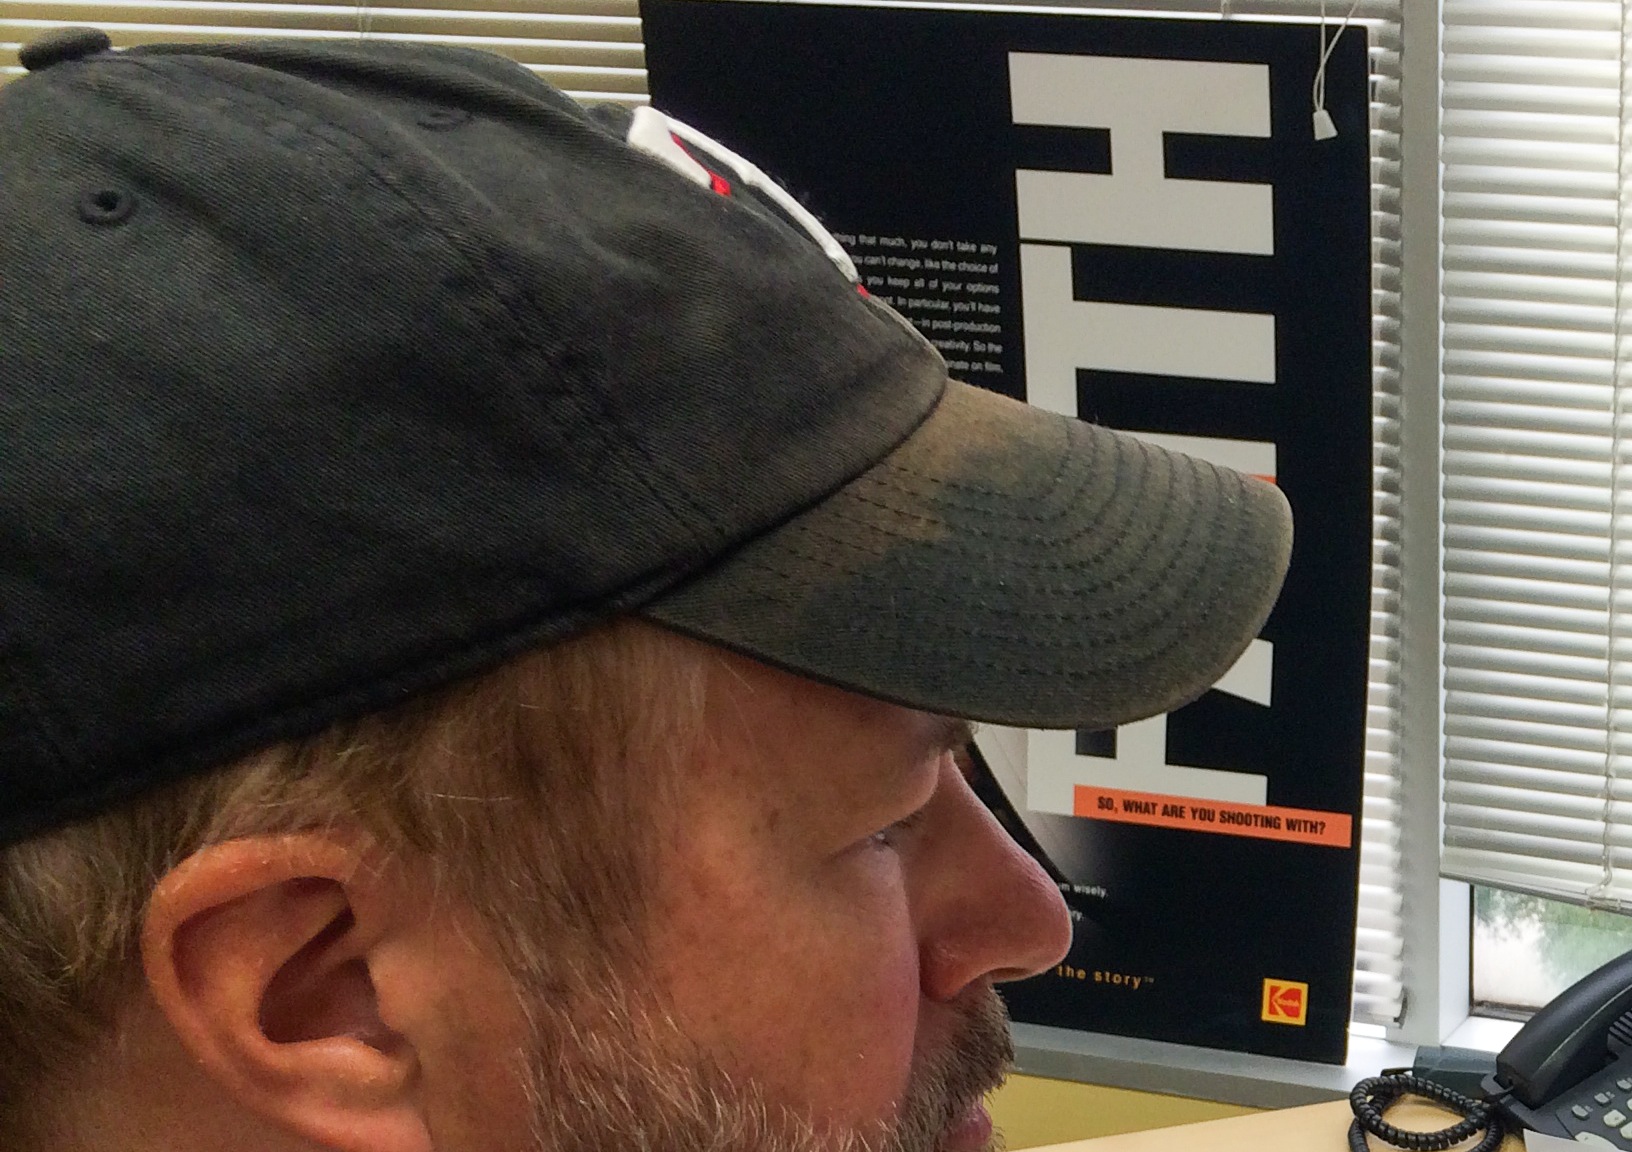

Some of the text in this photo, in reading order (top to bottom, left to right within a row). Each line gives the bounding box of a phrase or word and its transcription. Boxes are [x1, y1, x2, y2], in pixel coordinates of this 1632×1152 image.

[911, 239, 928, 250] you
[956, 242, 977, 253] take
[980, 244, 997, 256] any
[924, 259, 940, 269] like
[941, 260, 956, 270] the
[958, 261, 987, 273] choice
[989, 263, 998, 274] of
[867, 276, 999, 294] you keep all of your options
[978, 302, 1000, 314] have
[1008, 51, 1277, 817] FTH
[1098, 796, 1326, 835] SO, WHAT ARE YOU SHOOTING WITH?
[1057, 965, 1086, 980] the
